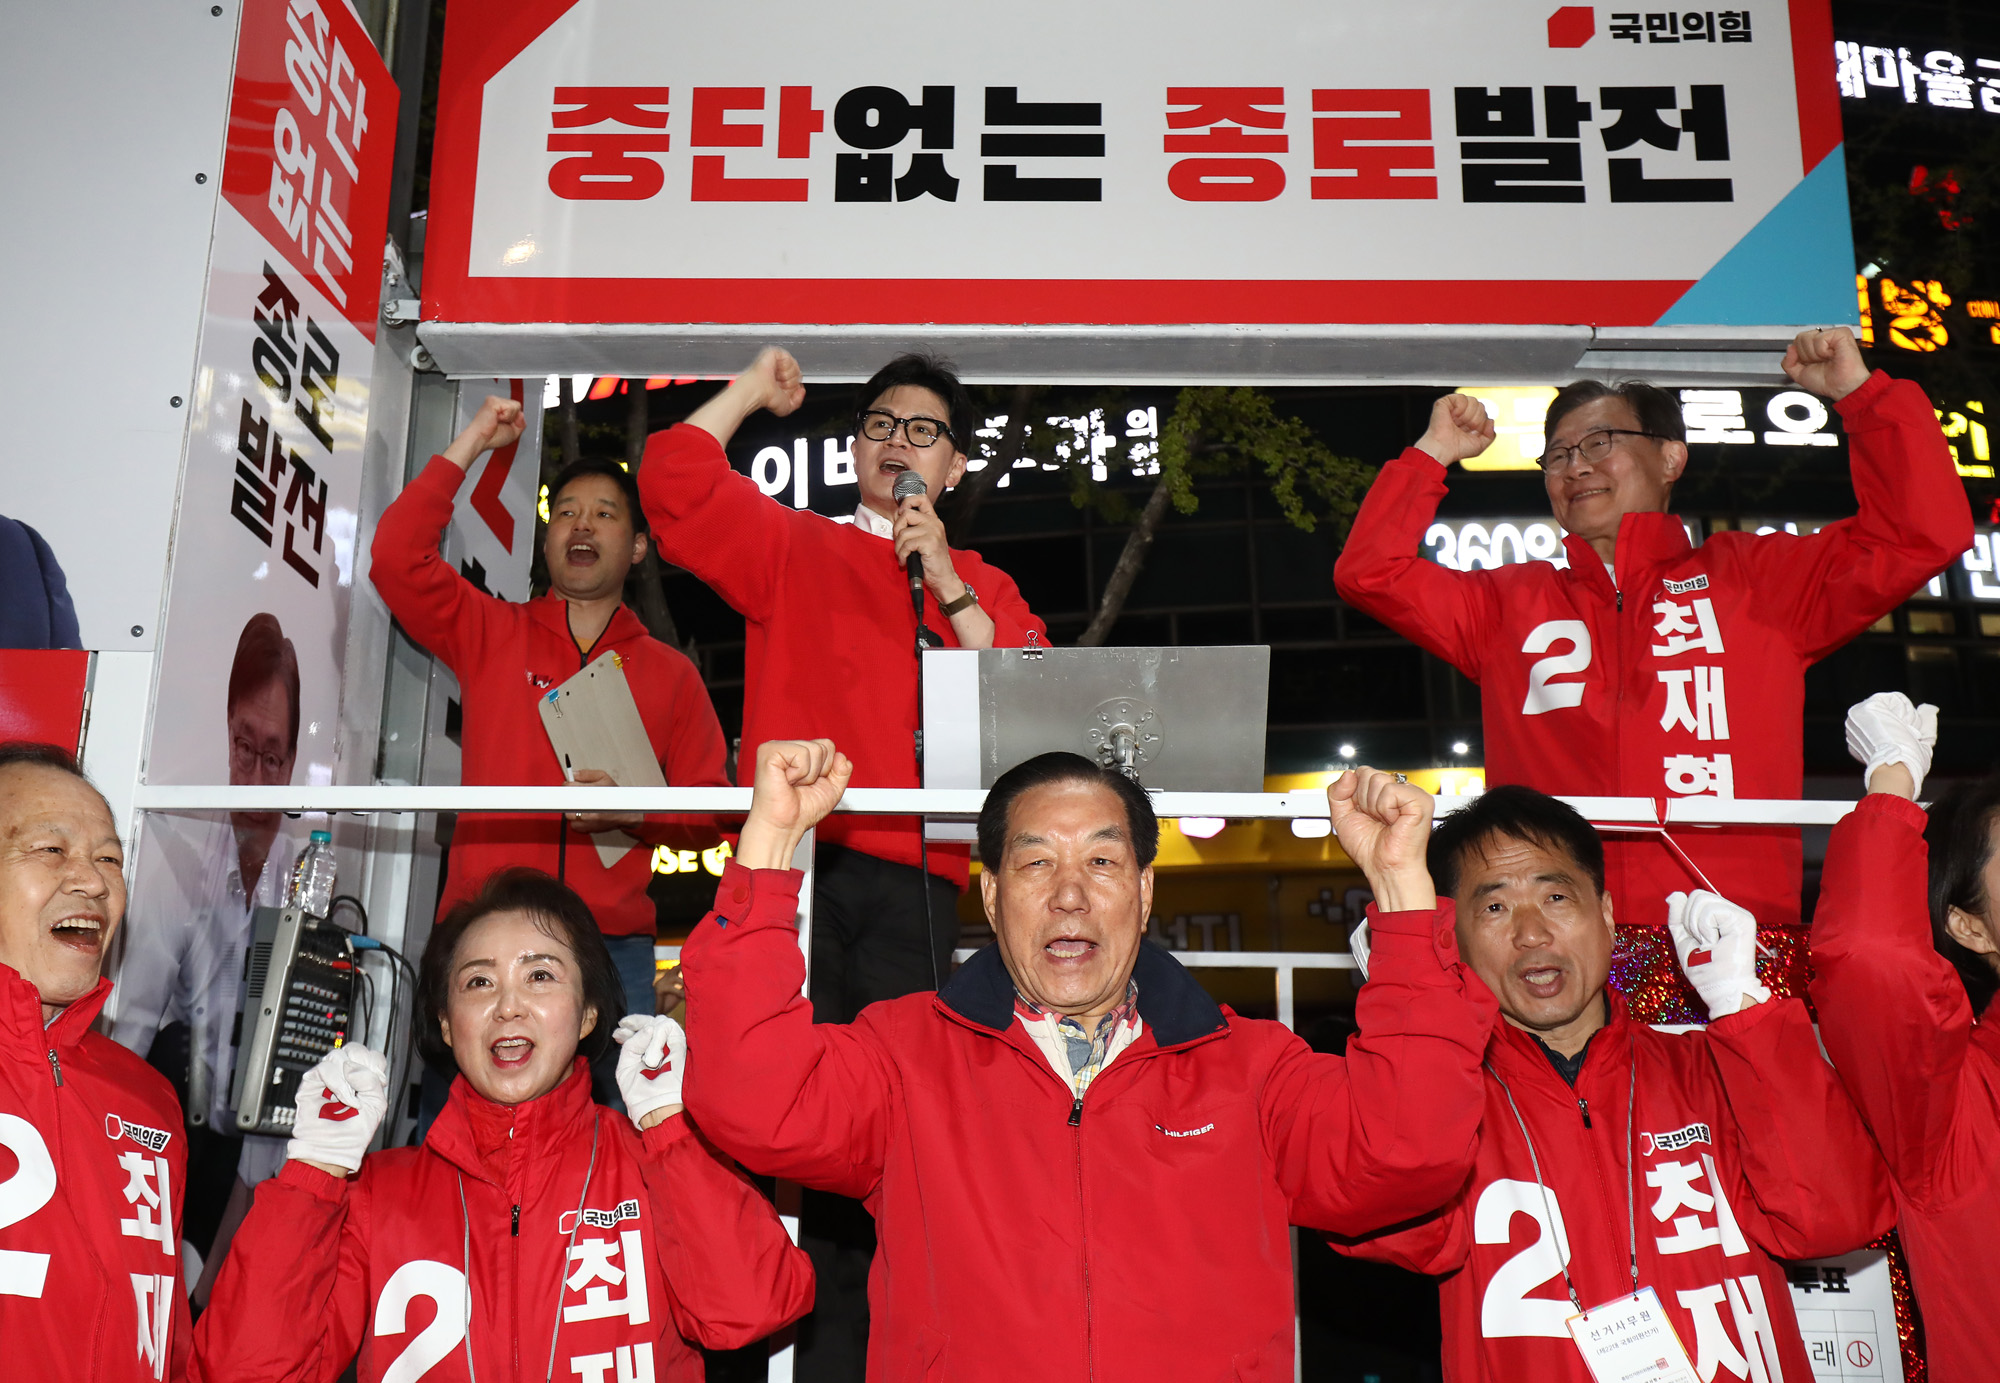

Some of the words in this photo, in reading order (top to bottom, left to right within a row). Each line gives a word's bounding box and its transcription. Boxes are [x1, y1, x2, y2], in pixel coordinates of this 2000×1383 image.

[1608, 10, 1752, 43] 국민의힘
[284, 0, 368, 184] 중단
[1163, 84, 1734, 204] 종로발전
[268, 107, 354, 310] 없는
[252, 259, 340, 455] 종로
[230, 397, 328, 590] 발전
[1664, 576, 1708, 593] 국민의힘
[1521, 620, 1592, 715] 2
[124, 1123, 168, 1150] 국민의힘
[1165, 1123, 1215, 1138] HILFIGER
[1657, 1125, 1710, 1149] 국민의힘
[585, 1202, 638, 1227] 국민의힘
[1474, 1178, 1576, 1338] 2
[374, 1259, 473, 1383] 2
[1590, 1310, 1651, 1341] 선거사무원
